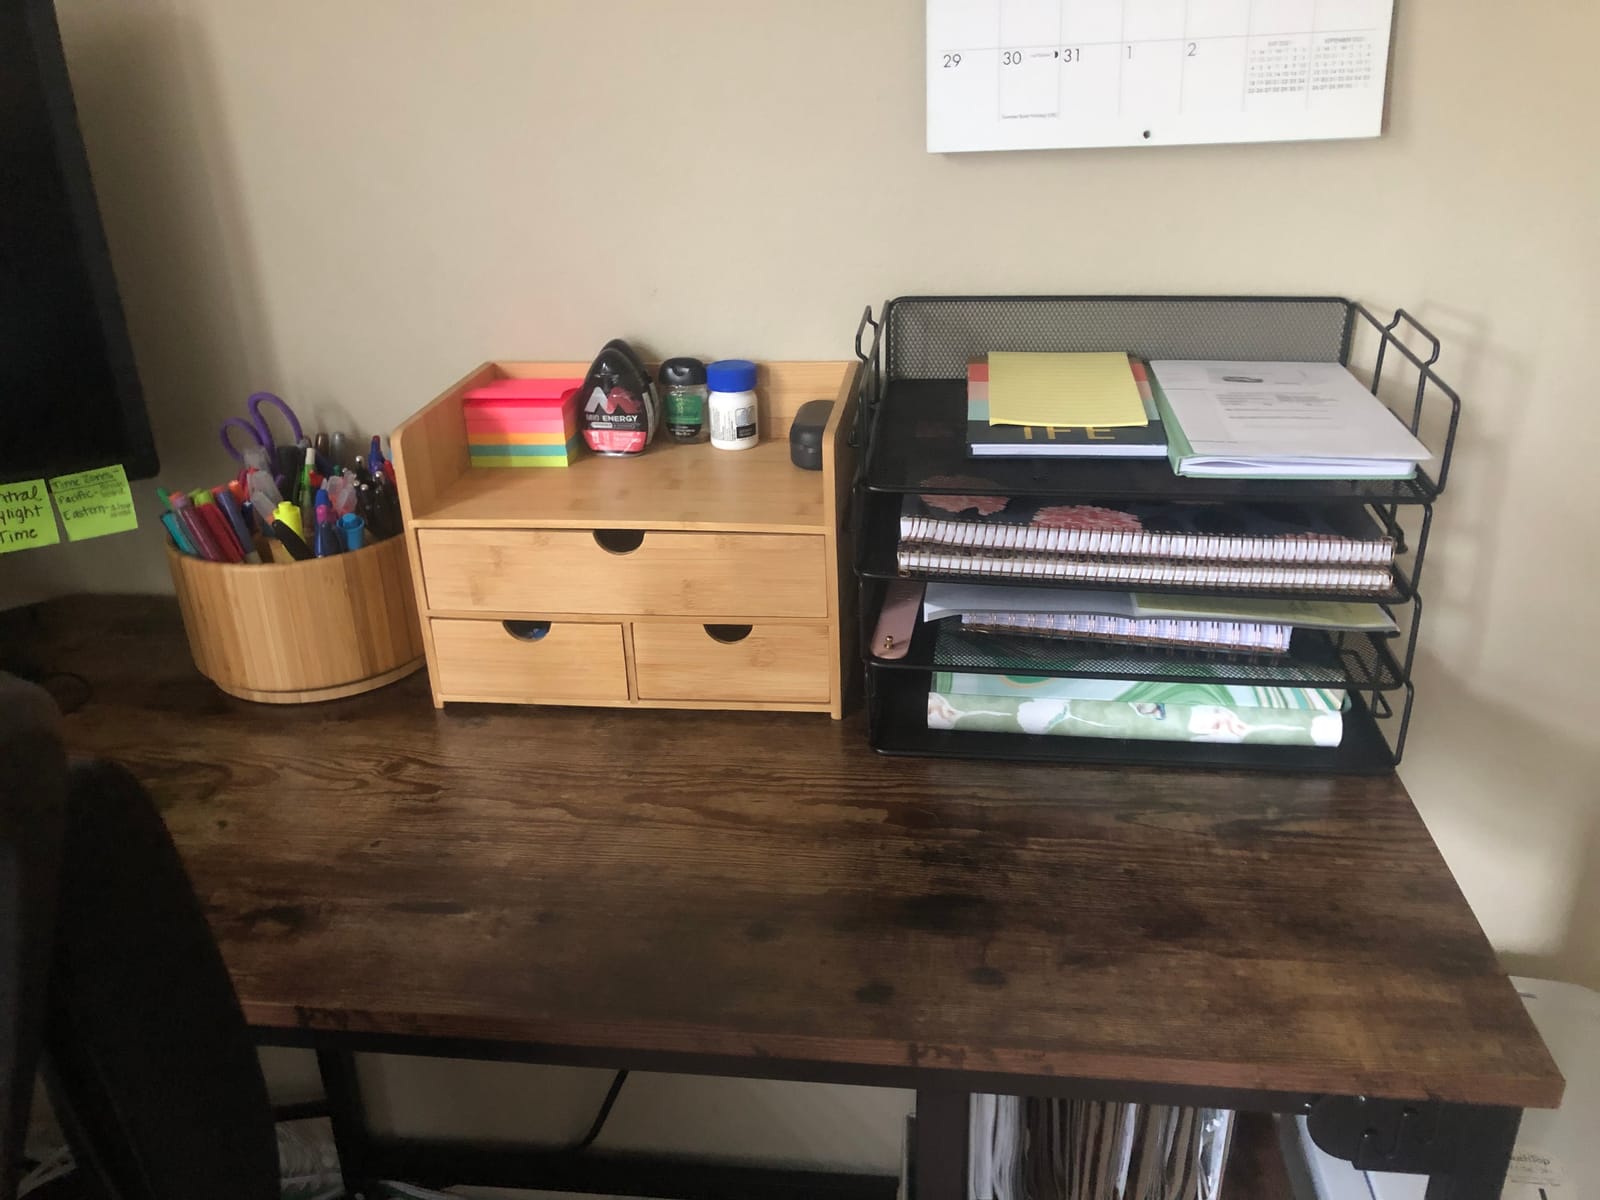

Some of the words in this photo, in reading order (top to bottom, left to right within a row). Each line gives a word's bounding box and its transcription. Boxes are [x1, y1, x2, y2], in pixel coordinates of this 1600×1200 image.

[1063, 48, 1081, 63] 31
[1126, 45, 1132, 60] 1
[1186, 42, 1197, 57] 2
[943, 54, 962, 68] 29
[1002, 50, 1022, 66] 30
